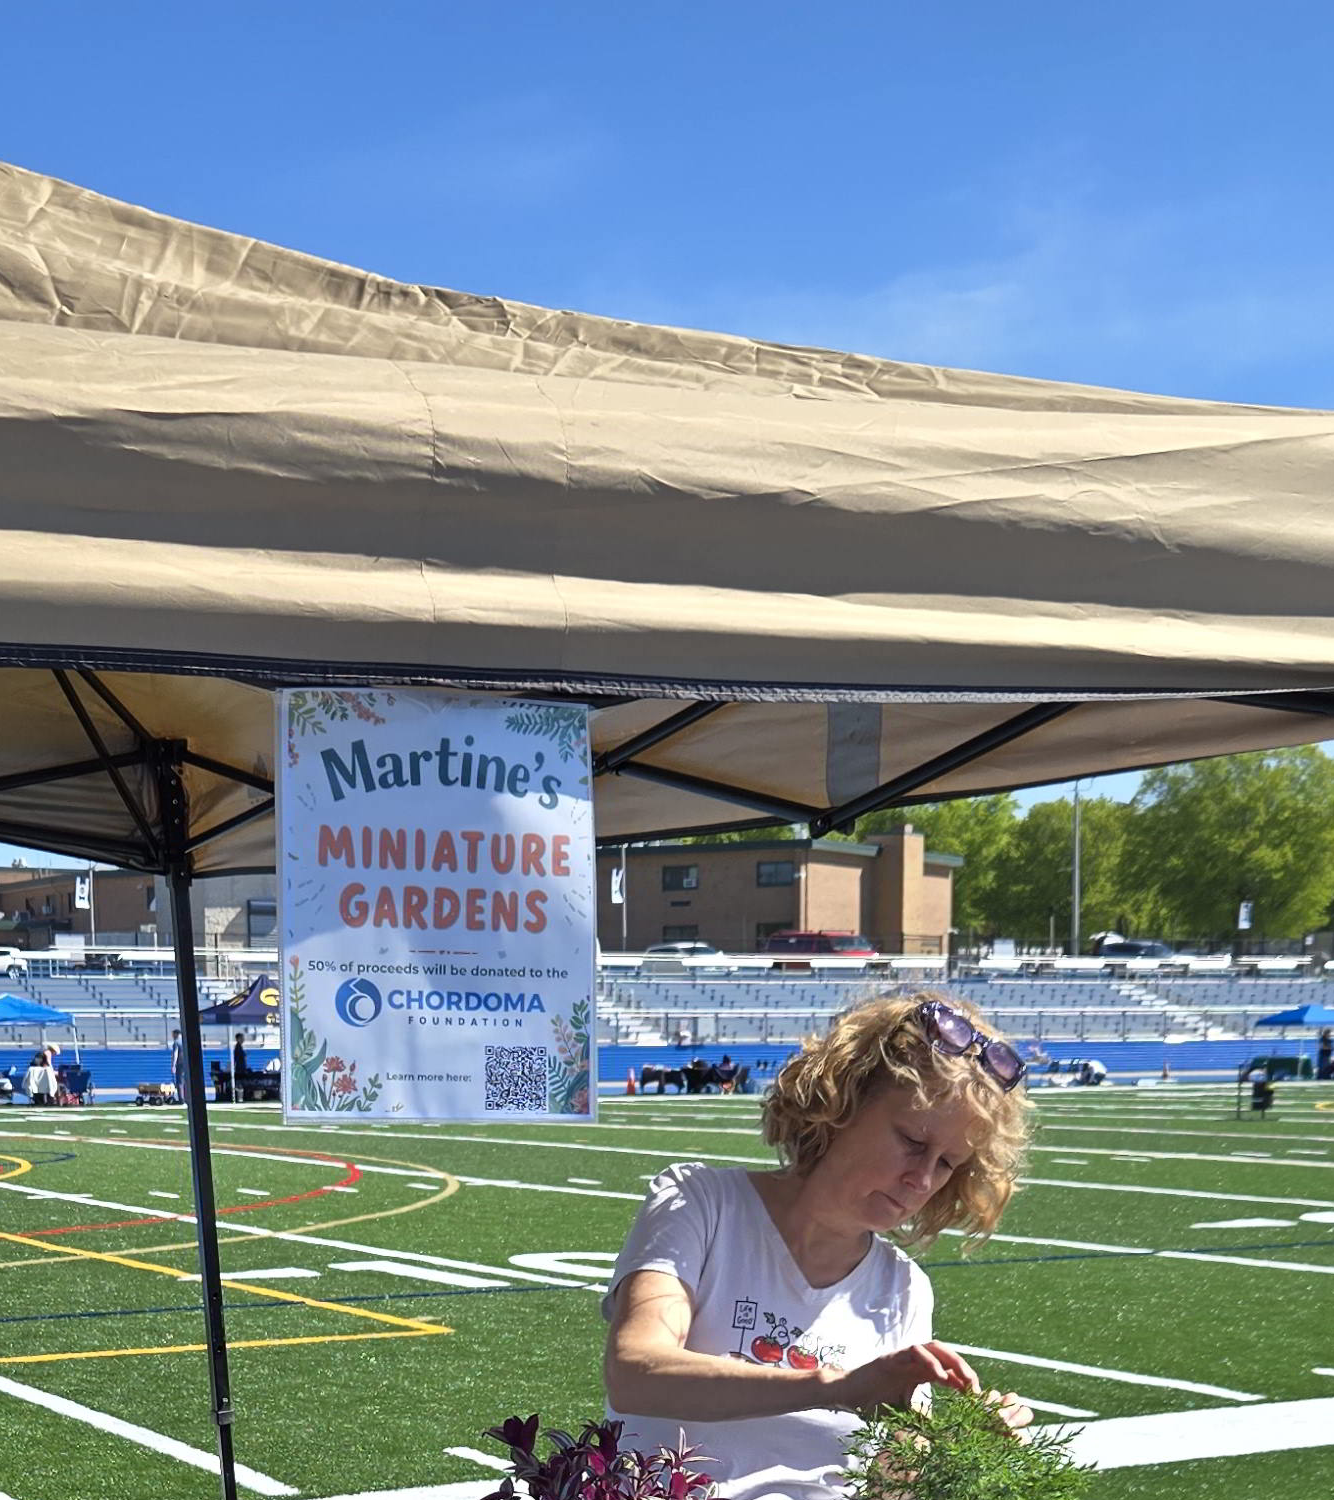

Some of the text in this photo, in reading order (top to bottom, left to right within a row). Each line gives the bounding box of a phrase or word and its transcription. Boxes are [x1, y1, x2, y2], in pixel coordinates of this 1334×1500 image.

[320, 735, 562, 810] Martine's
[317, 824, 571, 878] MINIATURE
[339, 882, 548, 934] GARDENS
[308, 960, 568, 980] 50% of proceeds will be donated to the
[387, 989, 546, 1014] CHORDOMA
[408, 1016, 523, 1028] FOUNDATION
[386, 1072, 472, 1083] Learn more here:
